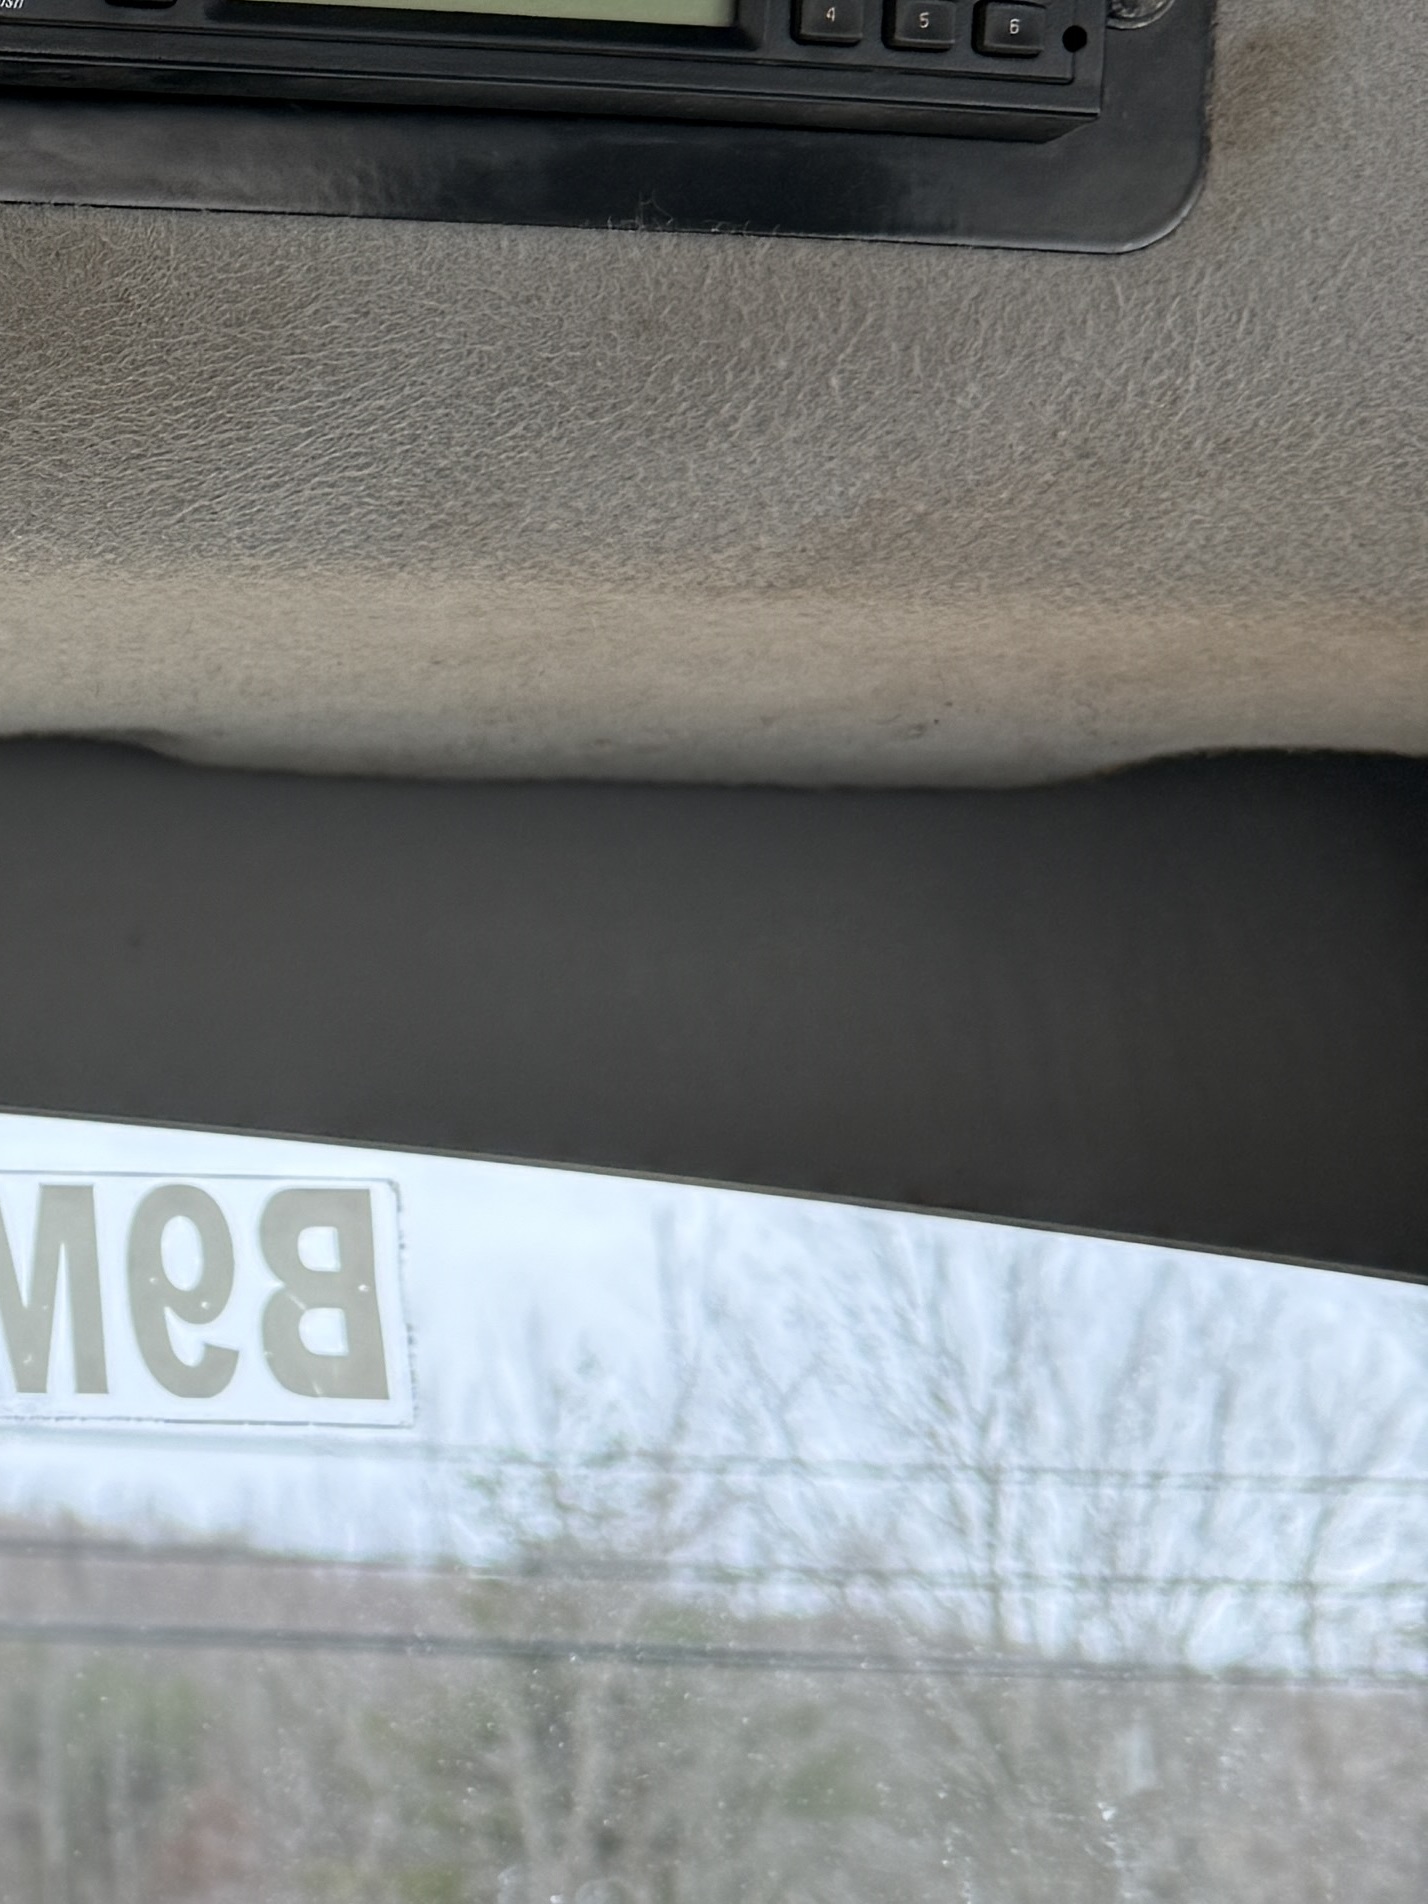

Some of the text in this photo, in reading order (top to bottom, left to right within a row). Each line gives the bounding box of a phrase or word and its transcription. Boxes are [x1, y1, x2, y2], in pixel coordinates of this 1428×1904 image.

[825, 6, 837, 22] 4
[918, 12, 930, 29] 5
[1008, 18, 1020, 35] 6
